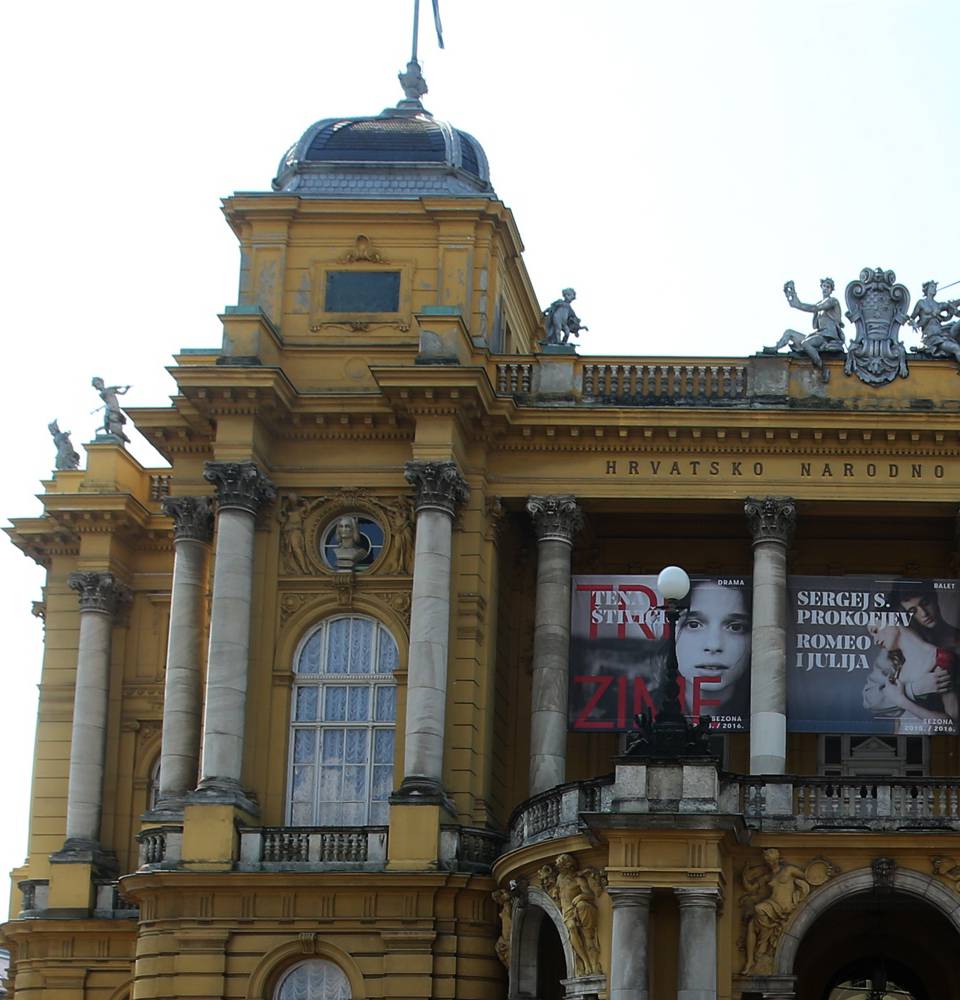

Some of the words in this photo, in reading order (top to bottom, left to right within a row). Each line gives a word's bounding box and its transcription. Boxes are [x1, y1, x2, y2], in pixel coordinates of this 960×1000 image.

[605, 461, 764, 476] HRVATSKO
[800, 463, 944, 478] NARODNO
[797, 591, 871, 610] SERGEJ
[874, 593, 891, 608] S.
[797, 609, 914, 630] PROKOFJEV
[796, 633, 872, 650] ROMEO
[796, 652, 804, 668] I
[806, 652, 870, 672] JULIJA
